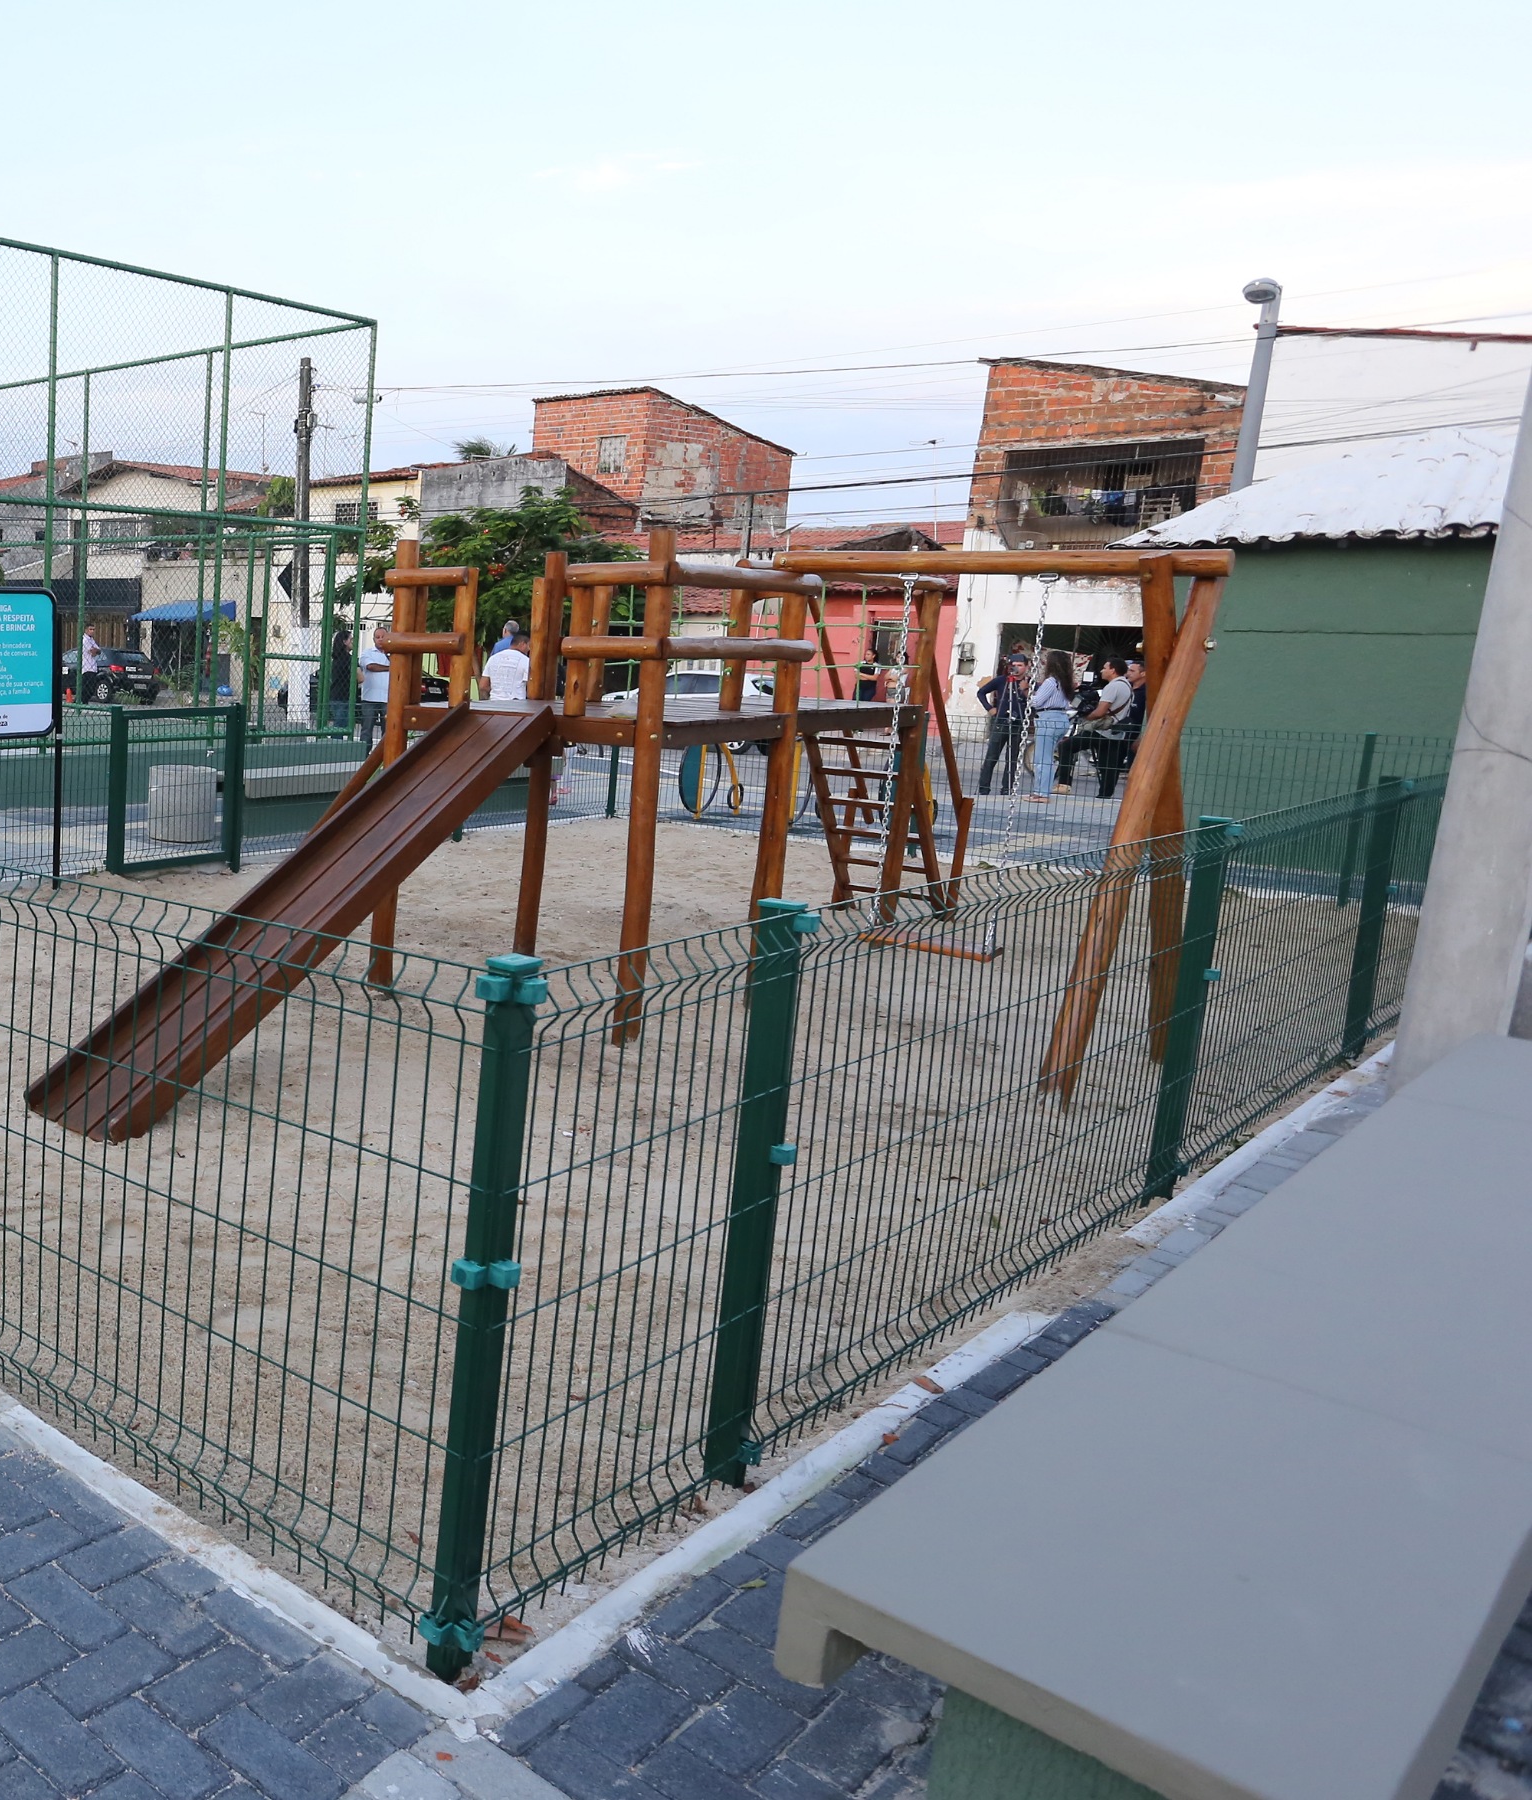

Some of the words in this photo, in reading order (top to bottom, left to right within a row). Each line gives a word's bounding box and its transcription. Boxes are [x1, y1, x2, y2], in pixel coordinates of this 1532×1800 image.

[3, 614, 35, 622] RESPEITA
[6, 623, 35, 632] BRINCAR
[12, 687, 31, 695] família
